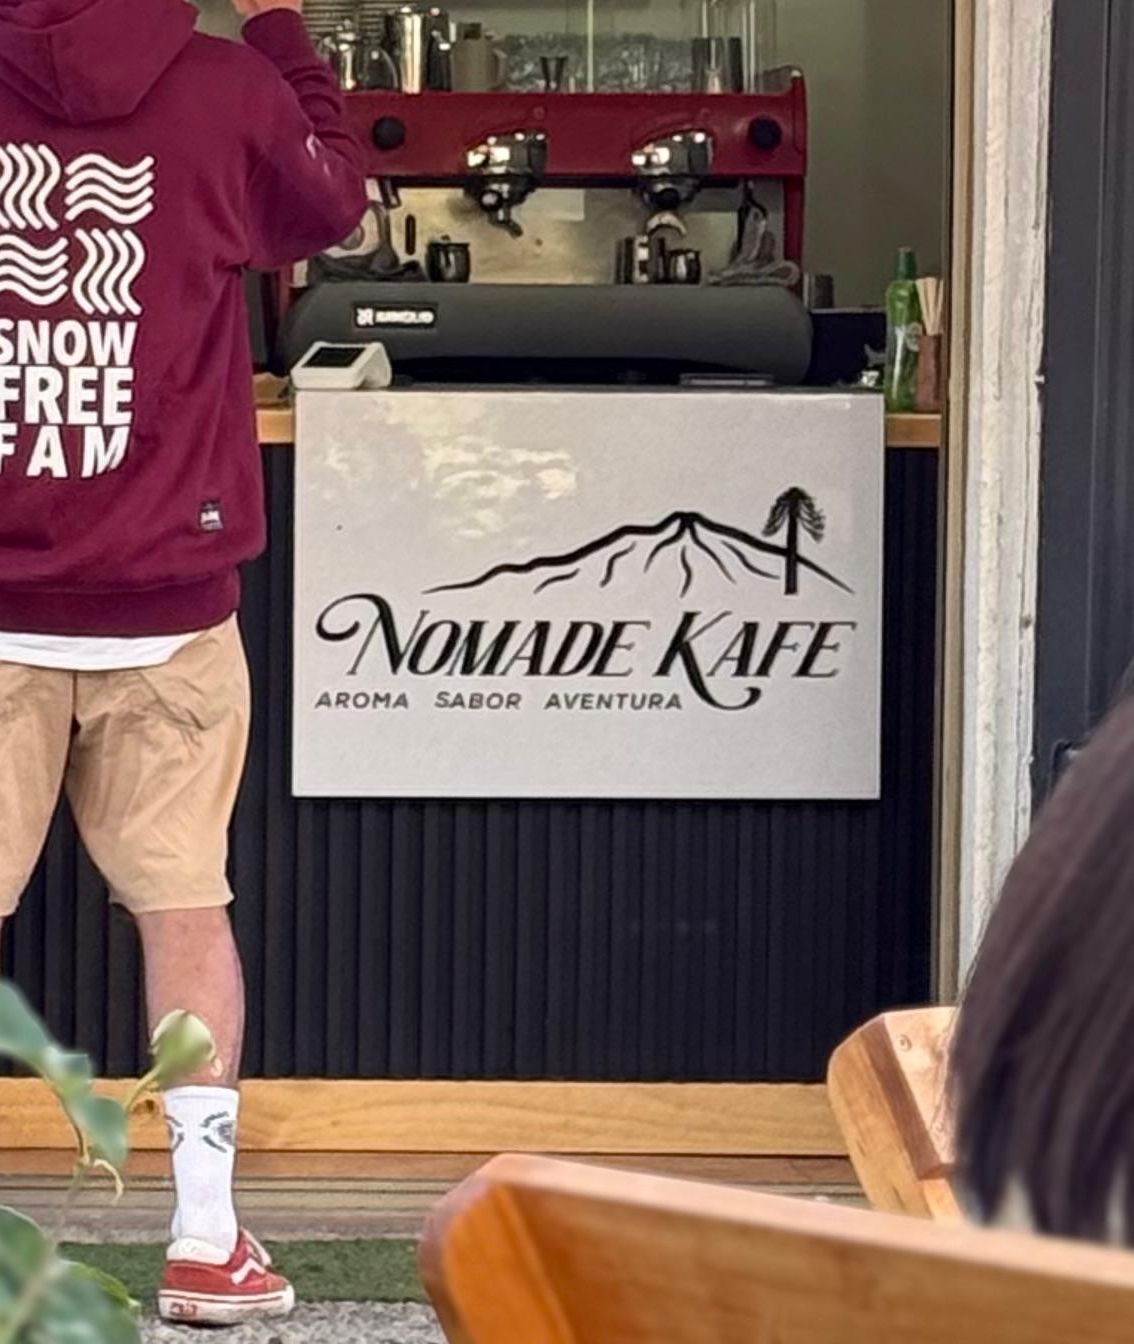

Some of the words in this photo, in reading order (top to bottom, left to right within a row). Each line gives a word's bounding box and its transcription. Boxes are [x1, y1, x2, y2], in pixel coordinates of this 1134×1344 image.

[315, 593, 651, 676] NOMADE
[652, 610, 857, 710] KAFE
[314, 691, 409, 710] AROMA
[434, 691, 522, 710] SABOR
[544, 691, 683, 711] AVENTURA
